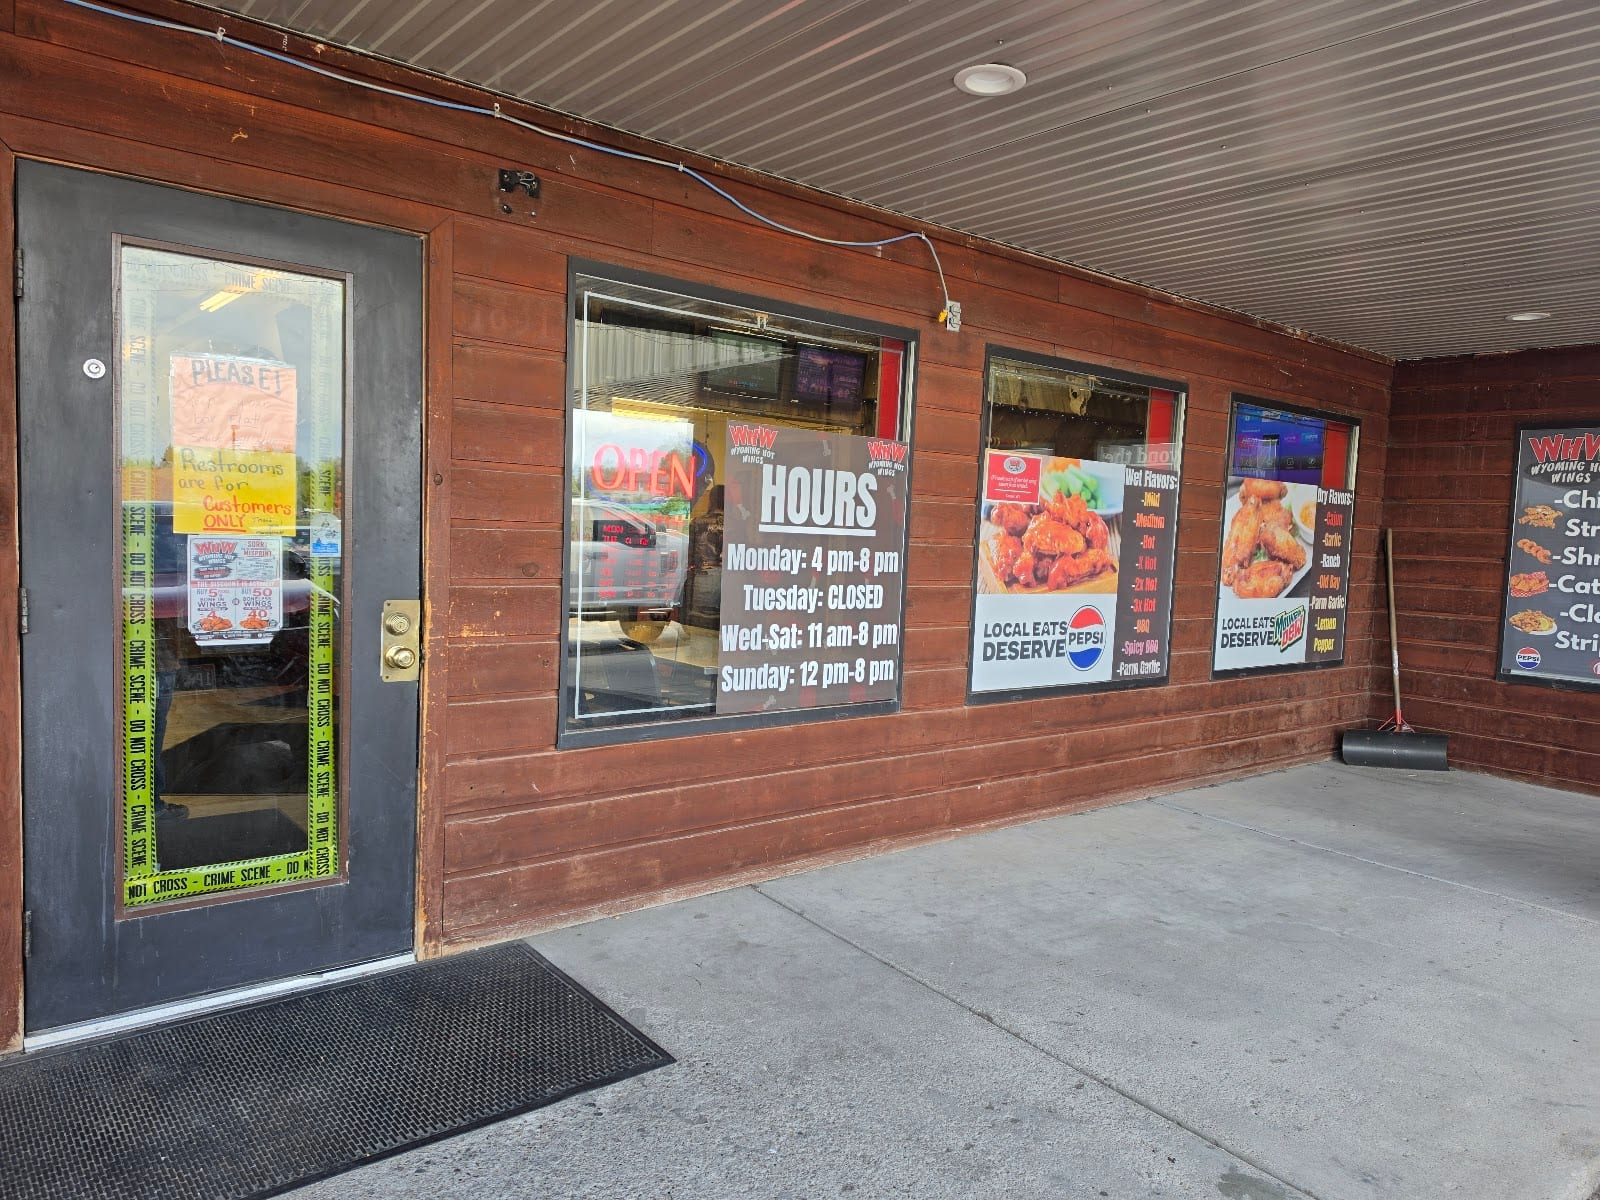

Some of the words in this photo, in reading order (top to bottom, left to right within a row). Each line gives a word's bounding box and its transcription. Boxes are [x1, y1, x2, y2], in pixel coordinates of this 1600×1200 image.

[225, 271, 257, 289] CRIME
[129, 335, 147, 366] SCENE
[191, 359, 283, 398] PLEASE!
[180, 447, 284, 476] Restrooms
[731, 446, 761, 456] WYOMING
[762, 449, 775, 460] HOT
[742, 455, 764, 465] WINGS
[592, 444, 697, 499] OPEN
[869, 460, 893, 470] WYOMING
[894, 462, 905, 472] HOT
[877, 468, 896, 477] WINGS
[1531, 460, 1587, 476] WYOMING
[129, 470, 147, 501] CRIME
[178, 478, 206, 490] are
[214, 475, 249, 491] for
[318, 470, 332, 498] SCENE
[1125, 467, 1143, 487] Wet
[1145, 470, 1178, 492] Flavors:
[1551, 473, 1592, 485] WINGS
[761, 463, 878, 529] HOURS
[1141, 491, 1160, 508] -Mild
[1317, 489, 1328, 506] Dry
[1328, 487, 1353, 506] Flavors:
[203, 495, 292, 516] Customers
[129, 506, 147, 537] SCENE
[203, 514, 247, 529] ONLY
[1133, 513, 1165, 529] -Medium
[1324, 512, 1343, 527] -Cajun
[1140, 535, 1156, 550] -Hot
[1322, 533, 1342, 548] -Garlic
[129, 552, 147, 566] DO
[318, 557, 332, 577] OSS
[727, 544, 807, 575] Monday:
[811, 547, 823, 572] 4
[827, 548, 871, 576] pm-8
[874, 551, 899, 577] pm
[1144, 556, 1157, 569] Hot
[1320, 553, 1341, 568] -Ranch
[129, 571, 147, 589] NOT
[1132, 577, 1144, 591] -2x
[1145, 577, 1157, 591] Hot
[1316, 575, 1329, 589] -Old
[1329, 575, 1341, 591] Bay
[252, 588, 273, 597] 50
[744, 584, 824, 614] Tuesday:
[828, 584, 884, 610] CLOSED
[129, 593, 147, 625] CROSS
[1130, 598, 1144, 612] -3x
[1144, 598, 1157, 612] Hot
[1309, 595, 1328, 610] -Parm
[1328, 595, 1345, 610] Garlic
[248, 609, 269, 618] 40
[984, 622, 1030, 638] LOCAL
[1033, 621, 1067, 637] EATS
[1133, 618, 1150, 634] -BBQ
[1222, 617, 1252, 631] LOCAL
[1253, 616, 1275, 629] EATS
[1315, 616, 1337, 631] -Lemon
[317, 621, 331, 650] SCENE
[722, 623, 803, 652] Wed-Sat:
[808, 623, 823, 649] 11
[827, 622, 868, 647] am-8
[872, 623, 898, 649] pm
[1068, 632, 1104, 646] PEPSI
[1221, 630, 1275, 649] DESERVE
[983, 639, 1066, 662] DESERVE
[1121, 640, 1144, 656] -Spicy
[1145, 639, 1159, 655] BBQ
[1313, 637, 1335, 654] Pepper
[1554, 631, 1600, 659] Stri
[129, 640, 147, 671] CRIME
[1517, 654, 1540, 662] PEPSI
[317, 663, 331, 675] DO
[721, 664, 795, 692] Sunday:
[799, 661, 818, 687] 12
[822, 658, 866, 689] pm-8
[869, 659, 895, 686] pm
[1117, 661, 1140, 677] -Parm
[1140, 660, 1161, 675] Garlic
[129, 674, 147, 705] SCENE
[317, 678, 331, 694] NOT
[317, 699, 331, 728] CROSS
[129, 719, 147, 733] DO
[129, 736, 147, 754] NOT
[317, 740, 331, 769] CRIME
[129, 760, 147, 791] CROSS
[317, 771, 331, 800] SCENE
[130, 804, 147, 835] CRIME
[317, 812, 331, 824] DO
[317, 827, 331, 843] NOT
[131, 838, 147, 869] SCENE
[316, 847, 331, 877] CROSS
[128, 884, 147, 900] NOT
[153, 877, 188, 895] CROSS
[203, 870, 236, 888] CRIME
[241, 866, 271, 883] SCENE
[286, 861, 299, 875] DO
